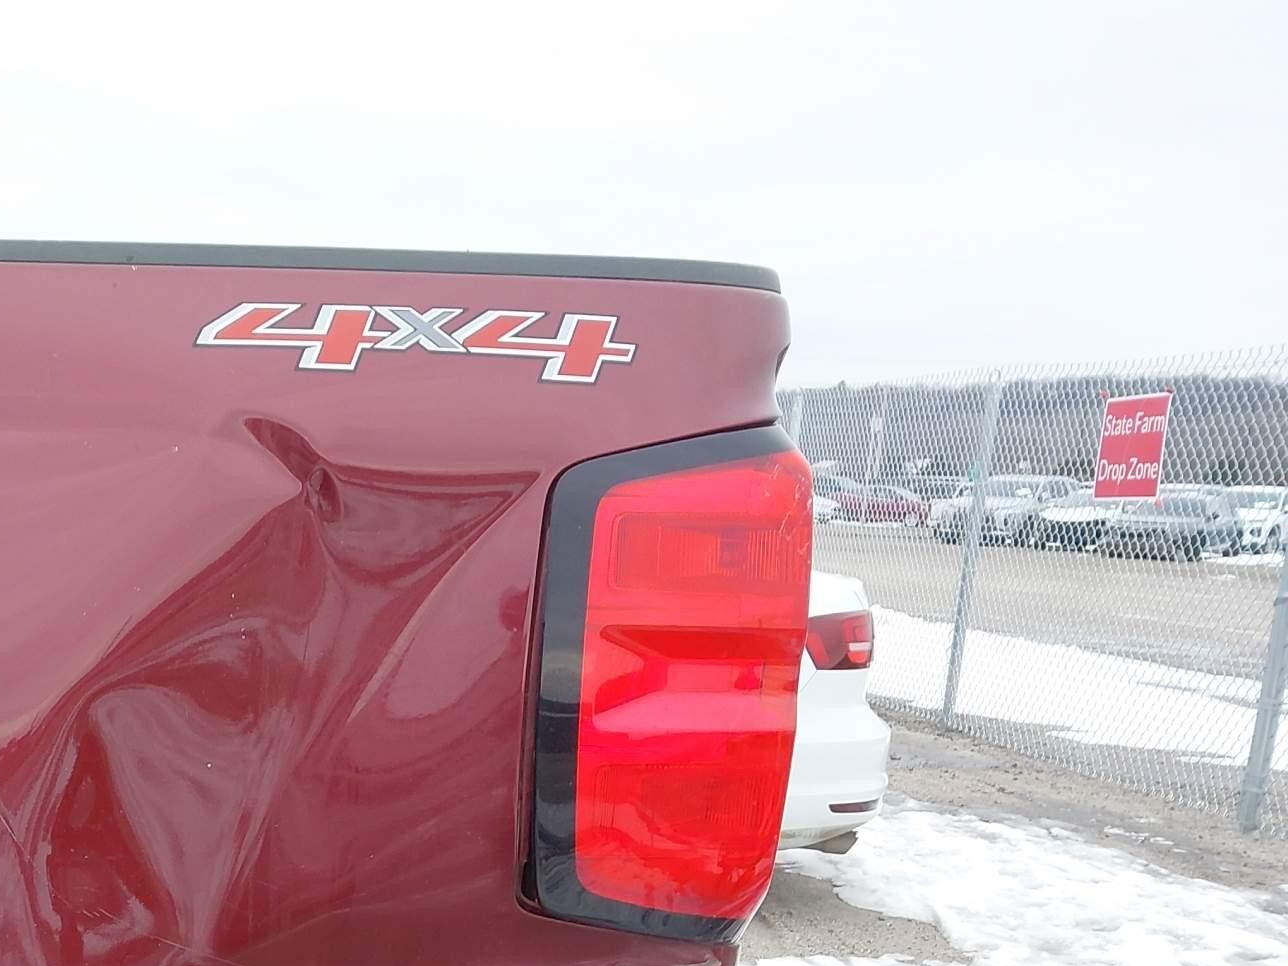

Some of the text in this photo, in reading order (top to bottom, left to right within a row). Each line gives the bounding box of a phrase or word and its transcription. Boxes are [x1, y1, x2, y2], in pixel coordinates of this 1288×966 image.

[1104, 411, 1165, 437] State Farm
[1098, 457, 1159, 486] Drop Zone
